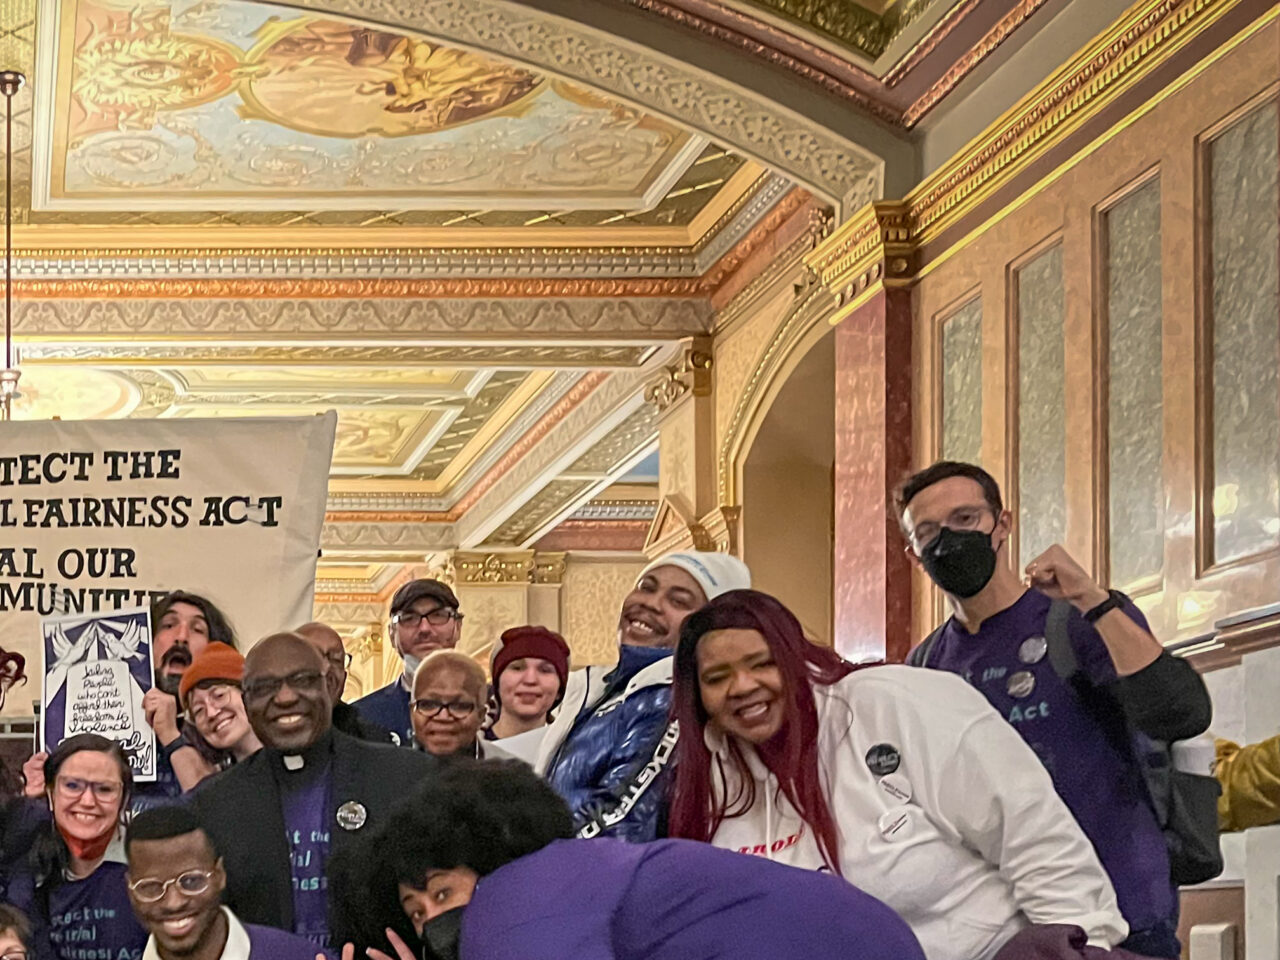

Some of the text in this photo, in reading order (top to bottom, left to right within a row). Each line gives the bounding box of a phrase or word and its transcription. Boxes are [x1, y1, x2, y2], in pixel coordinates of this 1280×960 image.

[103, 449, 181, 482] THE
[23, 495, 192, 528] FAIRNESS
[199, 496, 282, 527] ACT
[57, 548, 137, 580] OUR
[1009, 701, 1050, 722] Act
